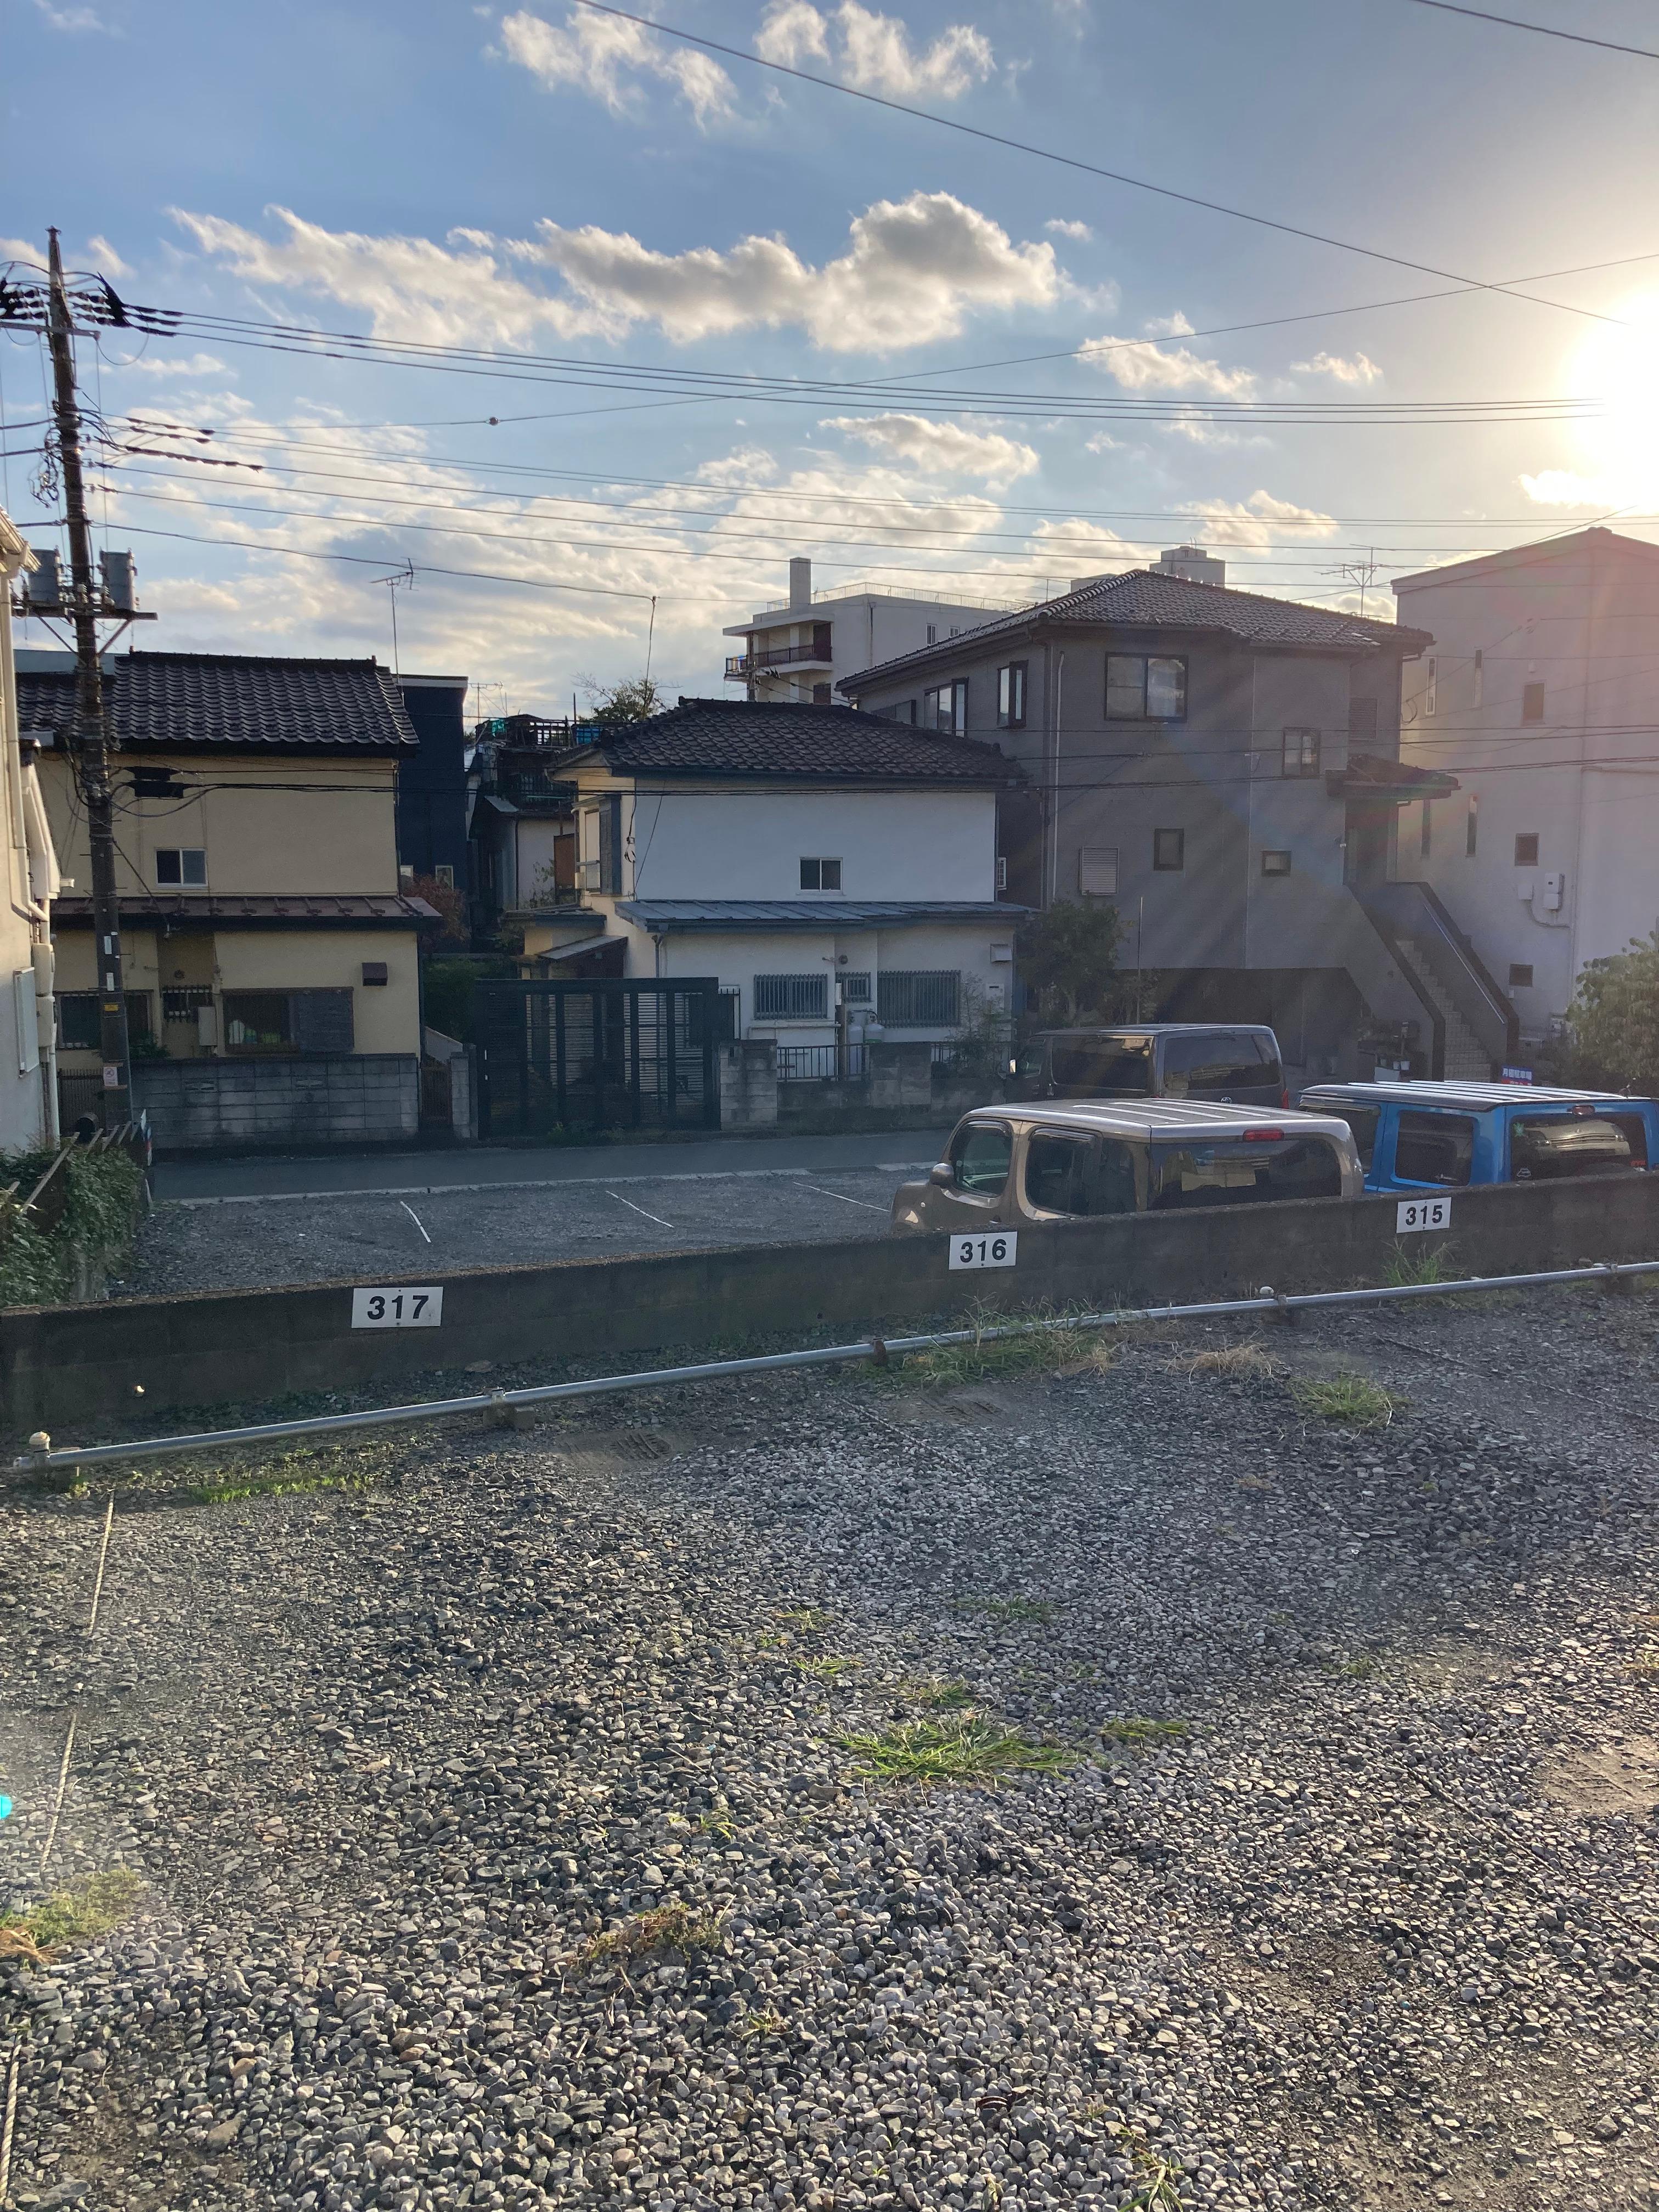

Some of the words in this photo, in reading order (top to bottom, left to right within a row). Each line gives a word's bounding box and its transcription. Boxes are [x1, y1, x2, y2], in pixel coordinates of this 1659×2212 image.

[1406, 1205, 1443, 1226] 315
[960, 1239, 1007, 1263] 316
[367, 1295, 429, 1320] 317
